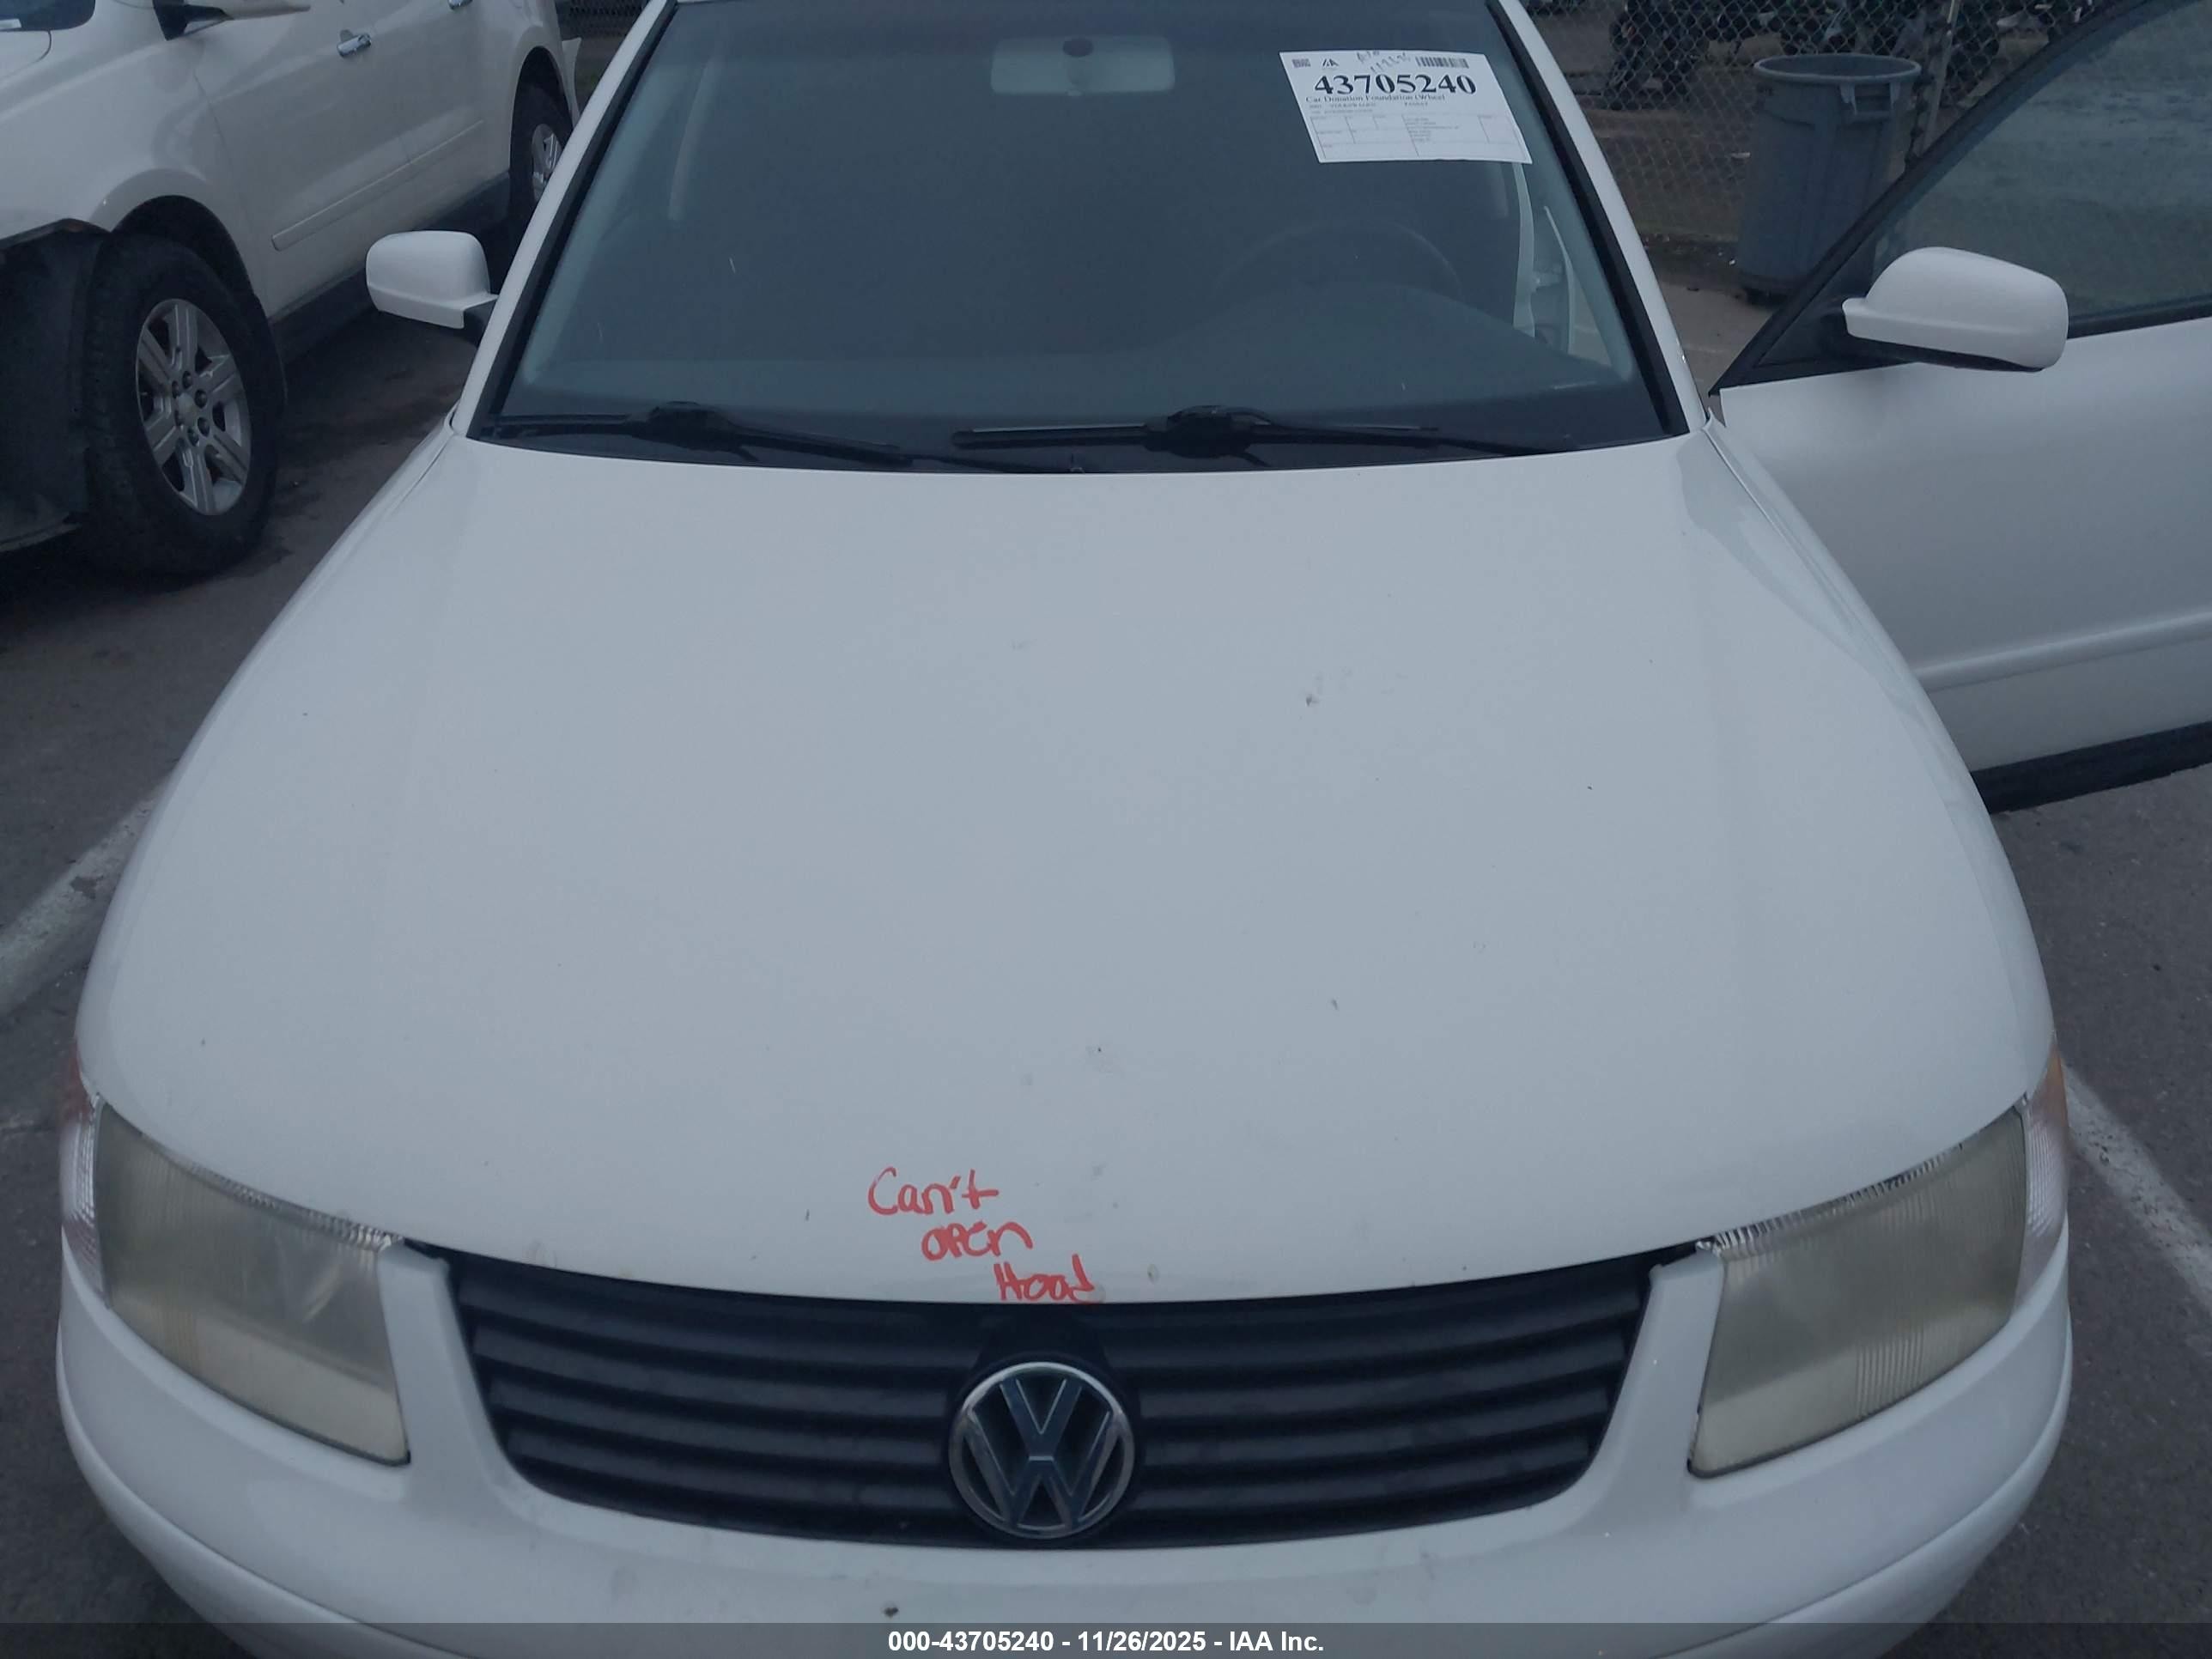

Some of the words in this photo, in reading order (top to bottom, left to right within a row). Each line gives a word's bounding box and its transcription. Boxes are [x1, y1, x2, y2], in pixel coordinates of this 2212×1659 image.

[1314, 74, 1476, 94] 43705240
[868, 1166, 999, 1215] Can't
[994, 1254, 1094, 1303] Hood
